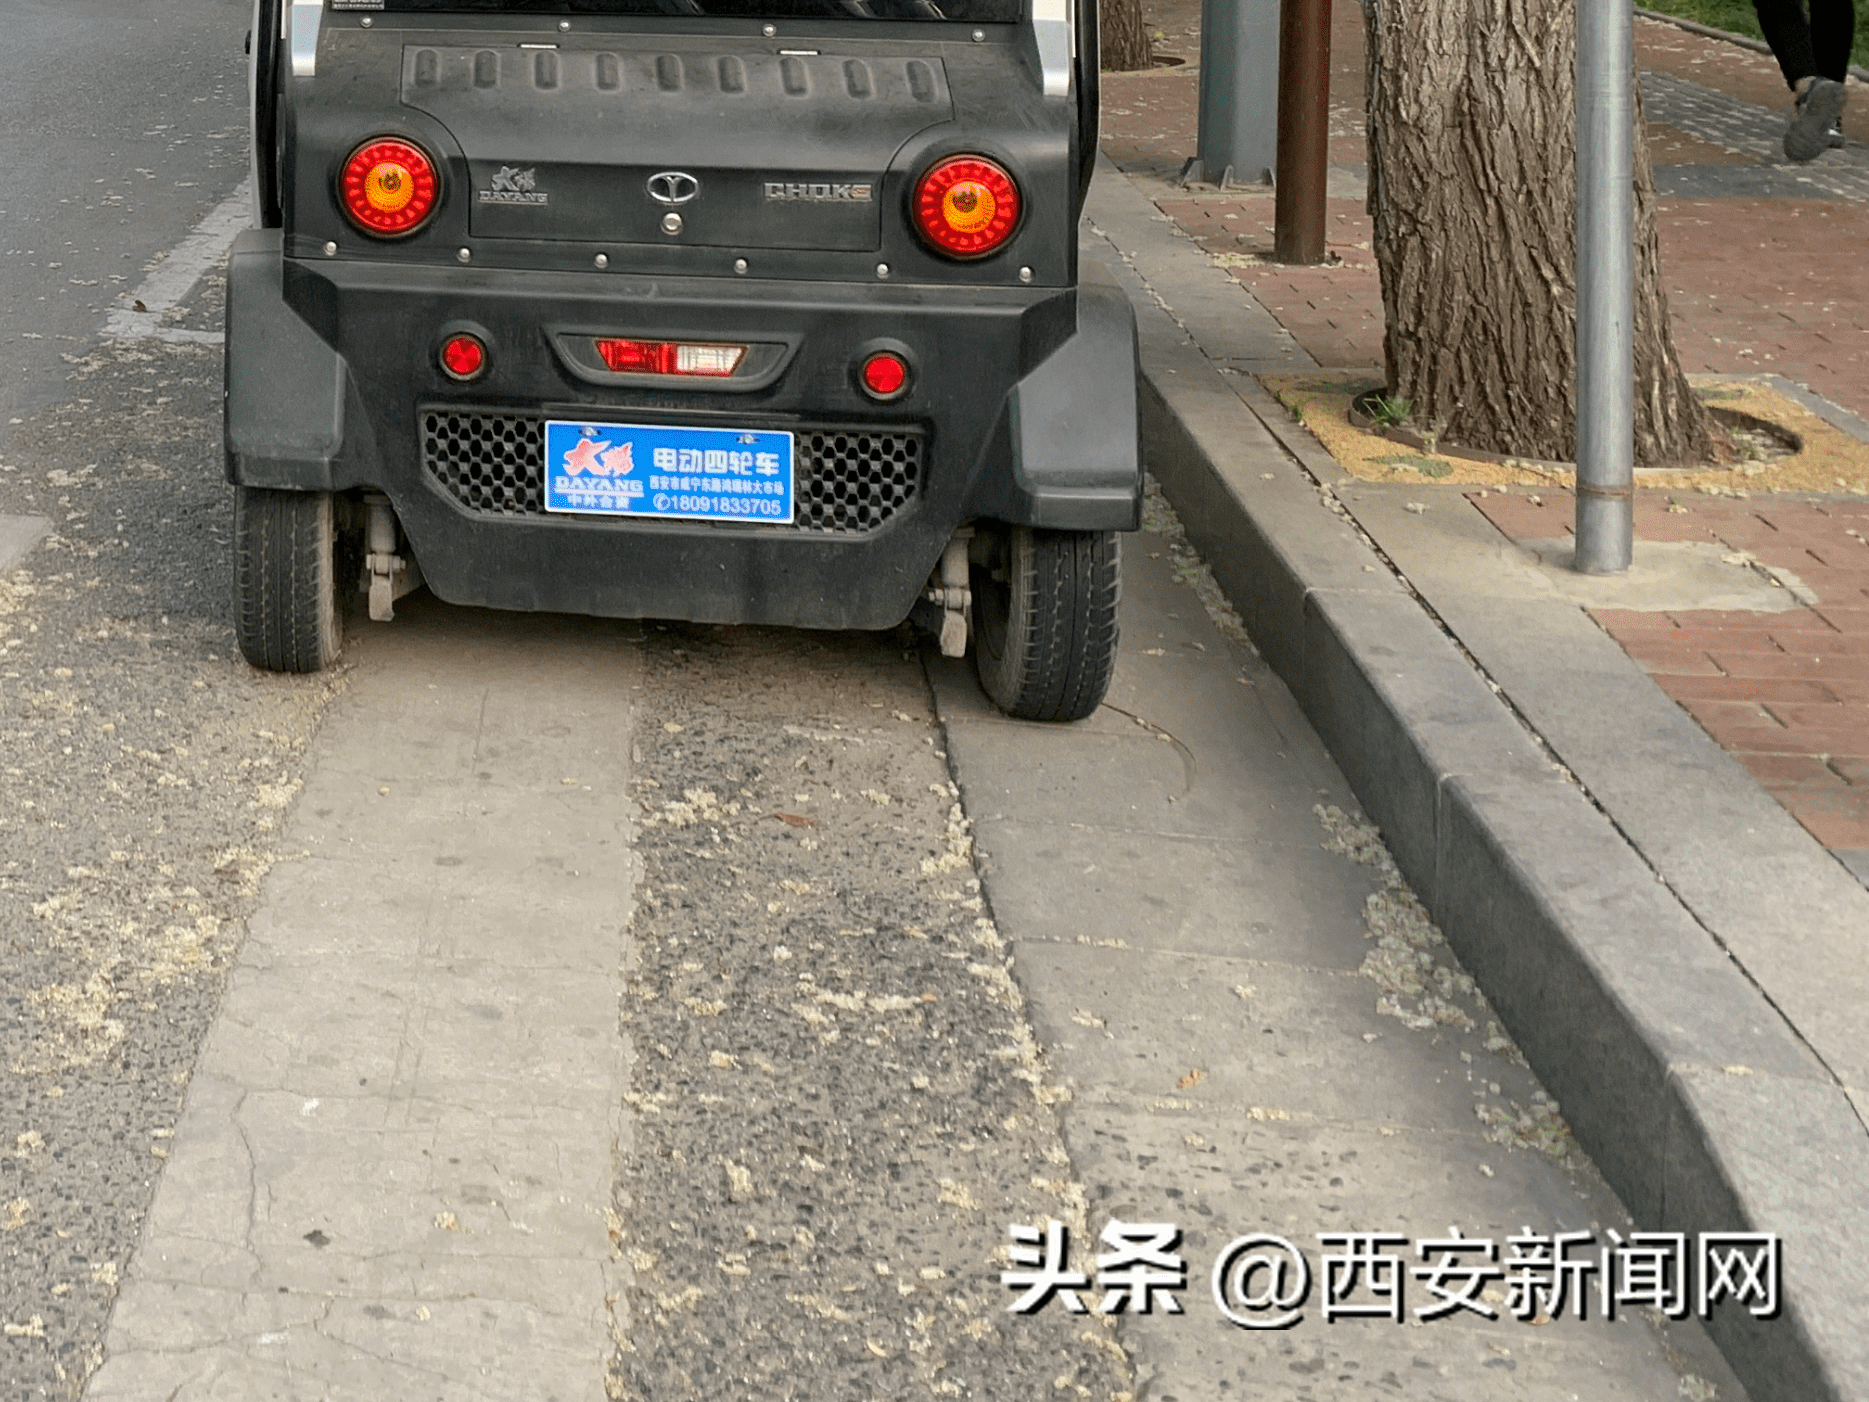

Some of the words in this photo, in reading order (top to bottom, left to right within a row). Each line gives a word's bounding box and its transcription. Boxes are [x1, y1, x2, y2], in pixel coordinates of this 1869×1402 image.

[479, 190, 548, 203] DAYANG
[652, 447, 780, 476] 电动四轮车
[555, 476, 644, 492] DAYANG
[670, 494, 782, 516] 18091833705
